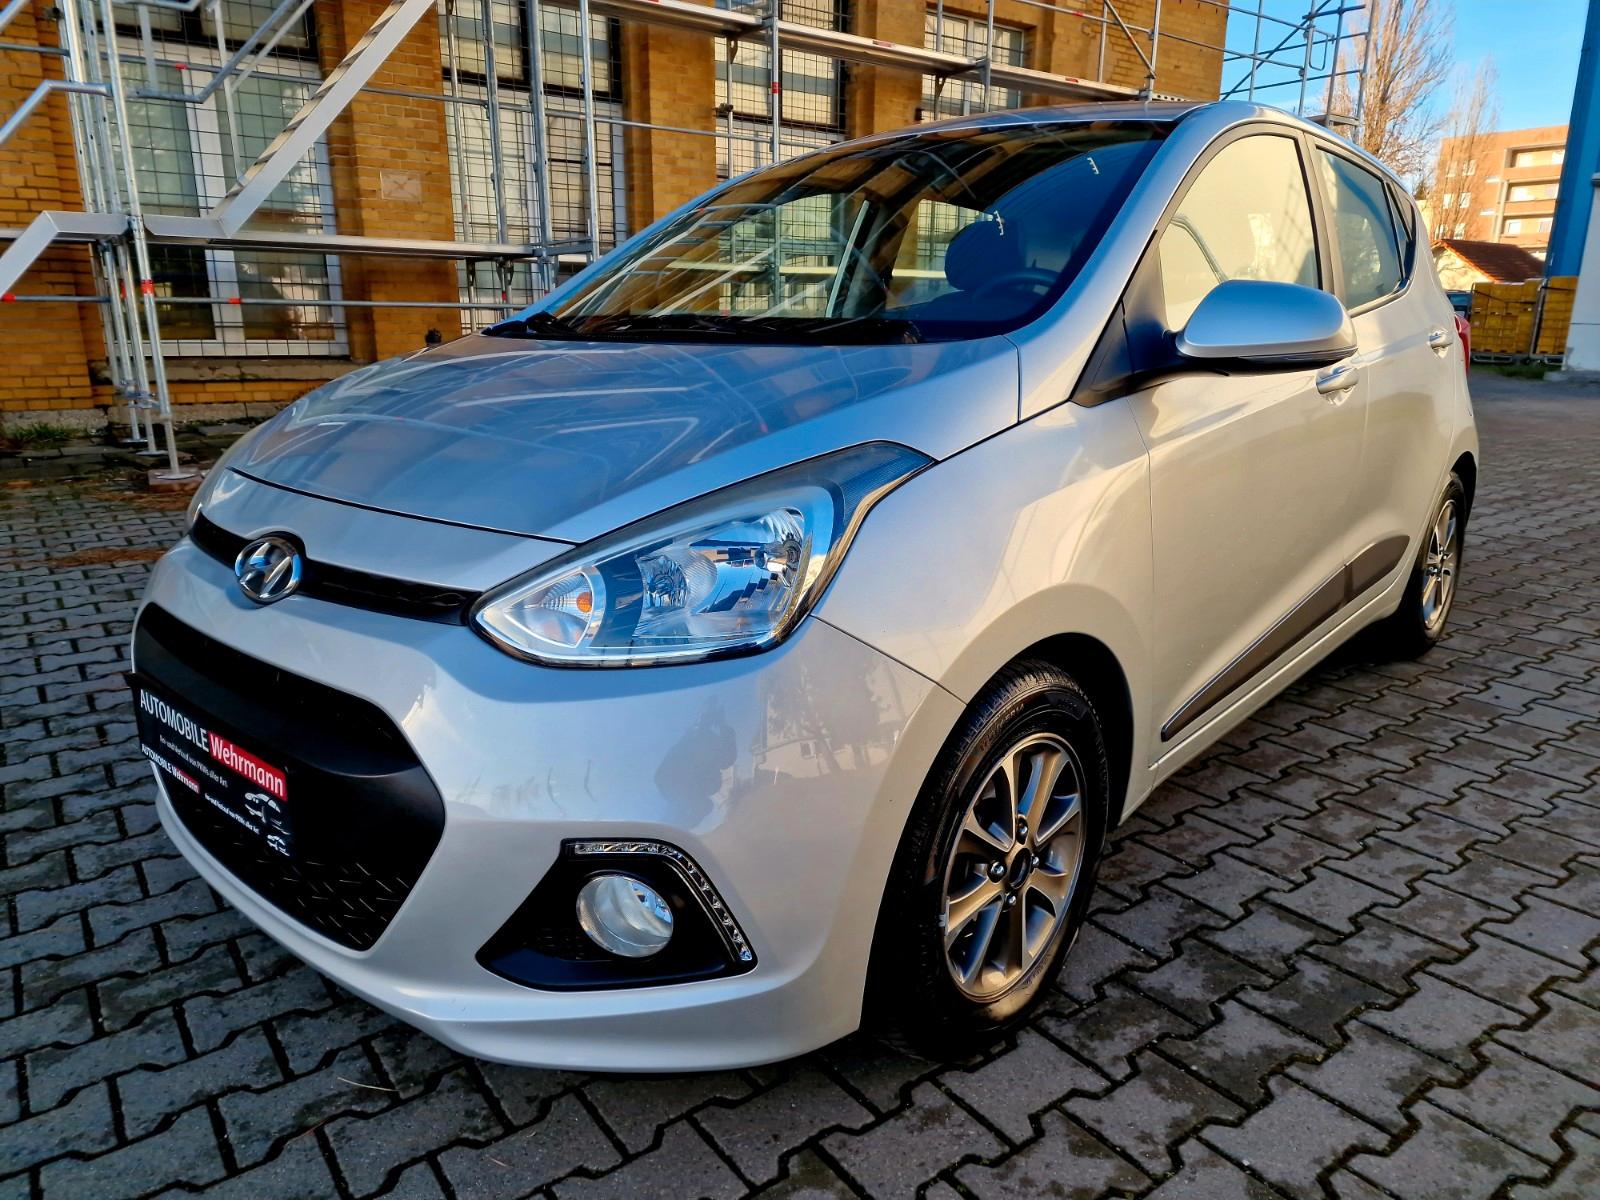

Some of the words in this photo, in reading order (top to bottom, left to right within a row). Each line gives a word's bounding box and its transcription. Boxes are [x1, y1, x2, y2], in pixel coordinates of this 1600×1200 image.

[140, 689, 209, 752] AUTOMOBILE
[210, 733, 284, 797] Wehrmann
[142, 743, 172, 774] AUTOMOBILE
[172, 766, 199, 794] Wehrmann
